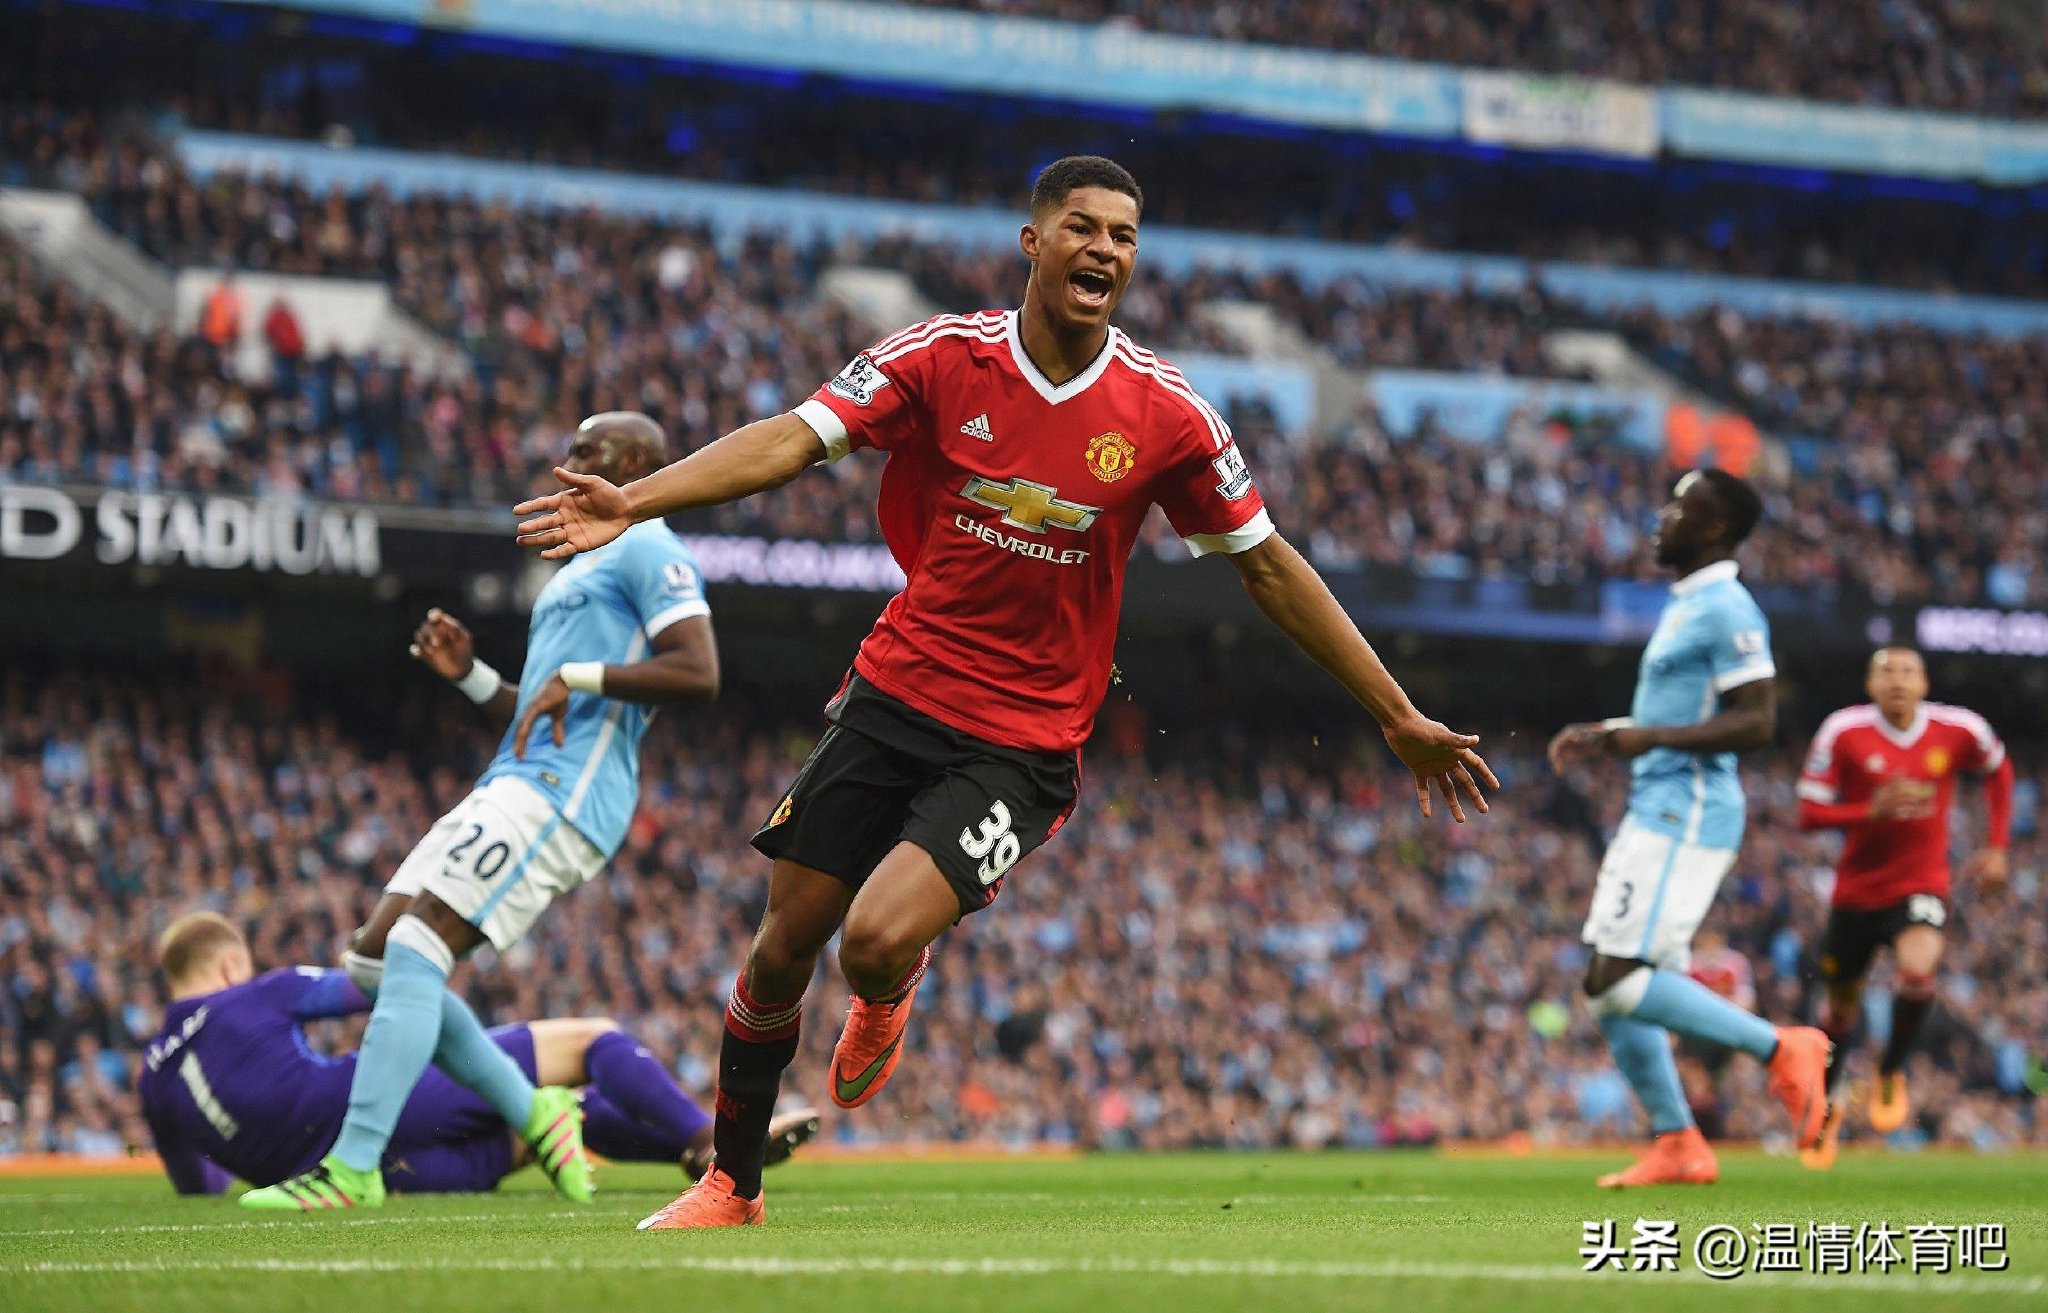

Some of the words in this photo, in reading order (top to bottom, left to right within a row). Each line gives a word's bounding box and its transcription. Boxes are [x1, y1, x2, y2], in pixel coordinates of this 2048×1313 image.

[960, 424, 994, 442] adidas
[1094, 467, 1121, 479] UNITED
[96, 488, 381, 579] STADIUM
[955, 513, 1090, 564] CHEVROLET
[448, 822, 510, 881] 20
[959, 800, 1021, 885] 39
[1614, 880, 1634, 920] 3
[178, 1050, 240, 1142] 1
